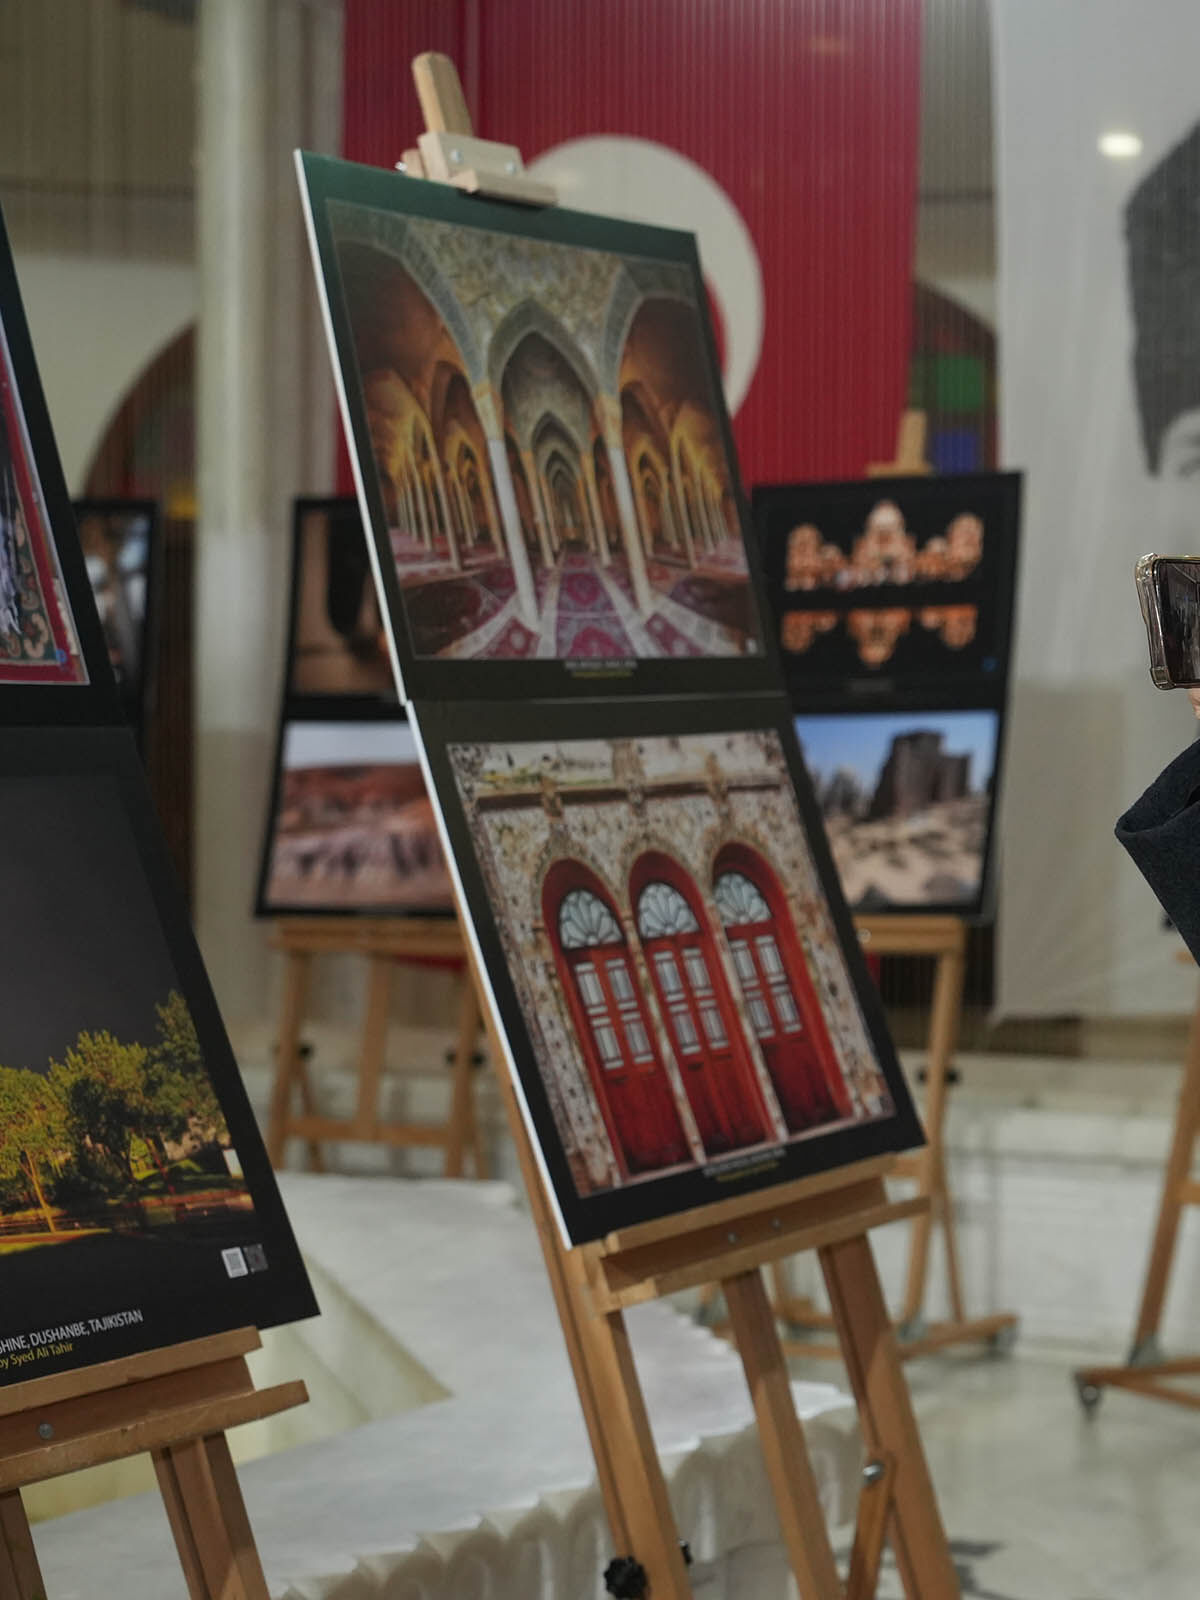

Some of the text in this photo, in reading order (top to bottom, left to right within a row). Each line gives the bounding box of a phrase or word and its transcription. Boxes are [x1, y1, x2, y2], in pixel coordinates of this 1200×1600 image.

[29, 1321, 90, 1346] DUSHANBE,
[88, 1310, 144, 1332] TAJIKISTAN
[10, 1351, 35, 1367] Syed
[36, 1346, 49, 1359] Ali
[49, 1342, 73, 1356] Tahir
